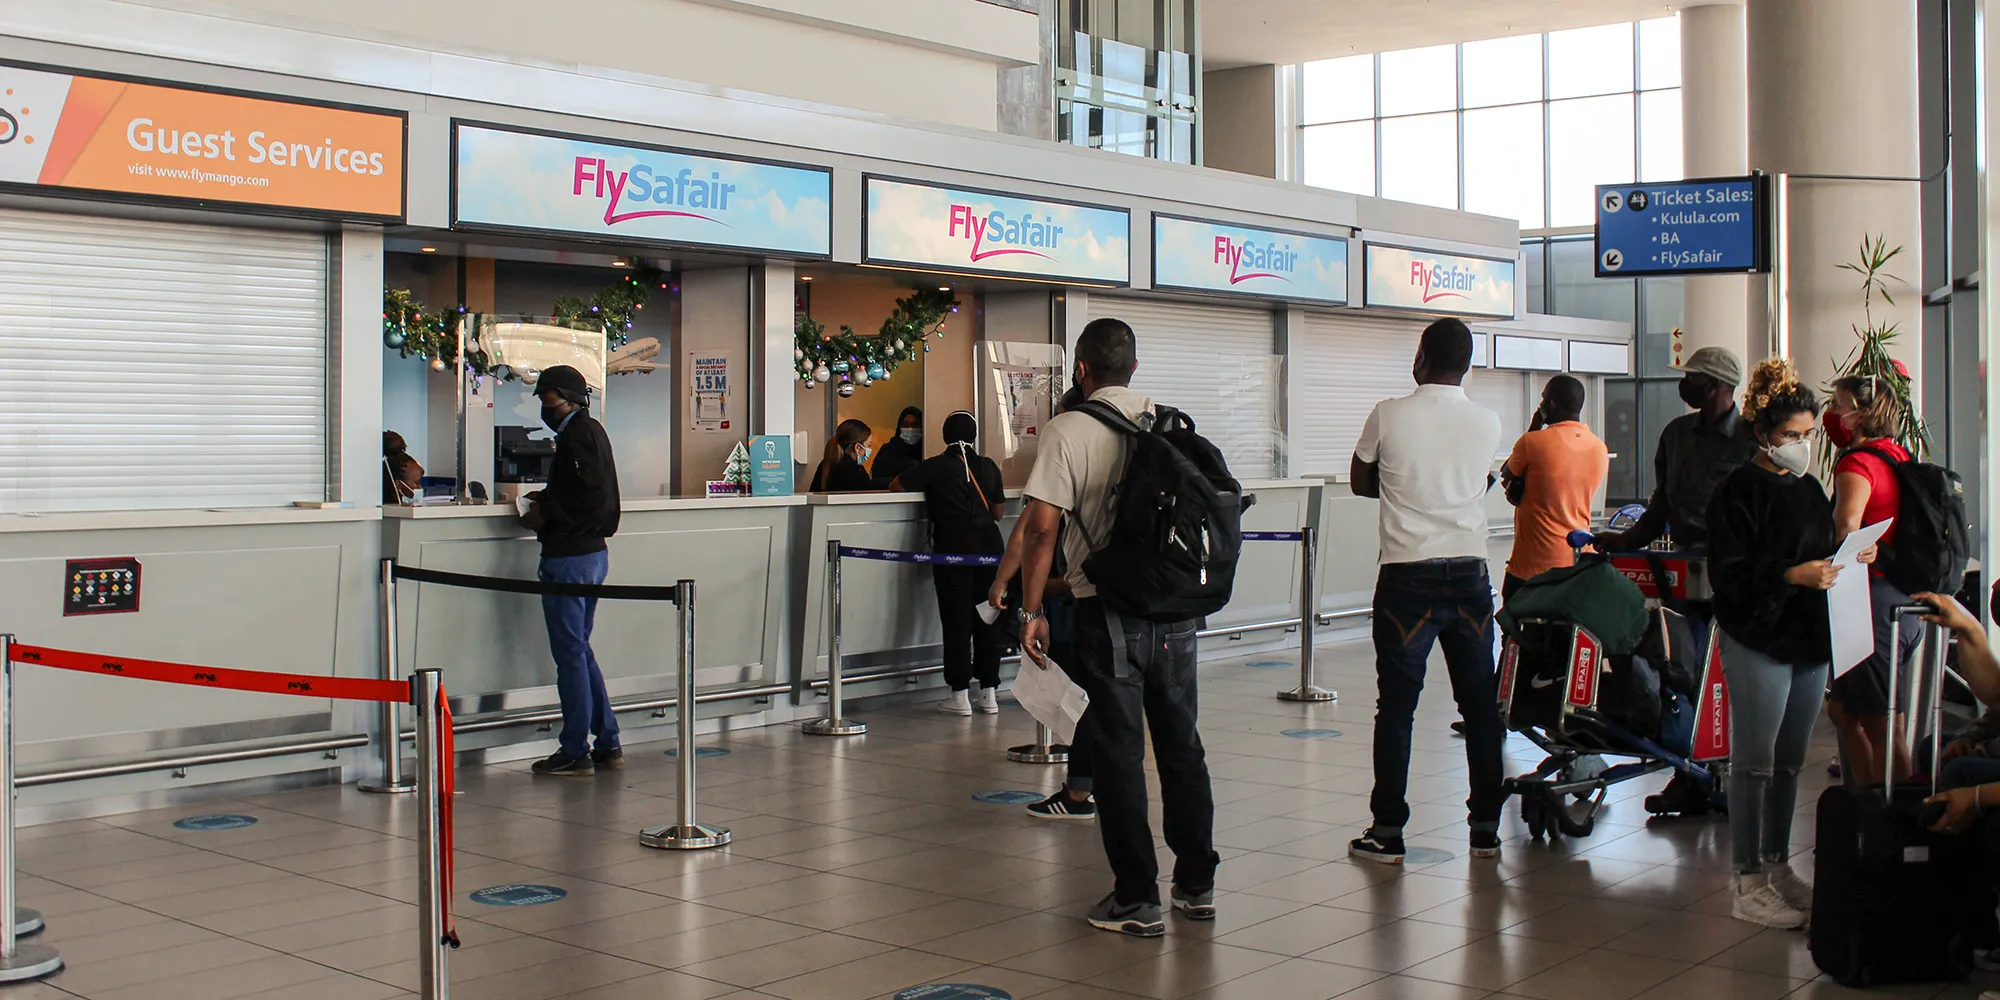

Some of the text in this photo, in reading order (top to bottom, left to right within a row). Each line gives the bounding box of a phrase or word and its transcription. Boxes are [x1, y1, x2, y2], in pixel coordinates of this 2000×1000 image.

[126, 117, 385, 176] Guest Services
[128, 163, 269, 187] visit www.flymango.com
[573, 155, 736, 226] FlySafair
[1651, 187, 1754, 207] Ticket Sales:
[949, 203, 1064, 262] FlySafair
[1660, 210, 1740, 225] Kulula.com
[1660, 231, 1681, 245] BA
[1213, 235, 1298, 285] FlySafair
[1660, 249, 1723, 267] FlySafair
[1410, 260, 1476, 303] FlySafair
[696, 376, 726, 389] 1.5 M
[1577, 659, 1588, 690] SPAR
[1713, 698, 1722, 736] SPAR
